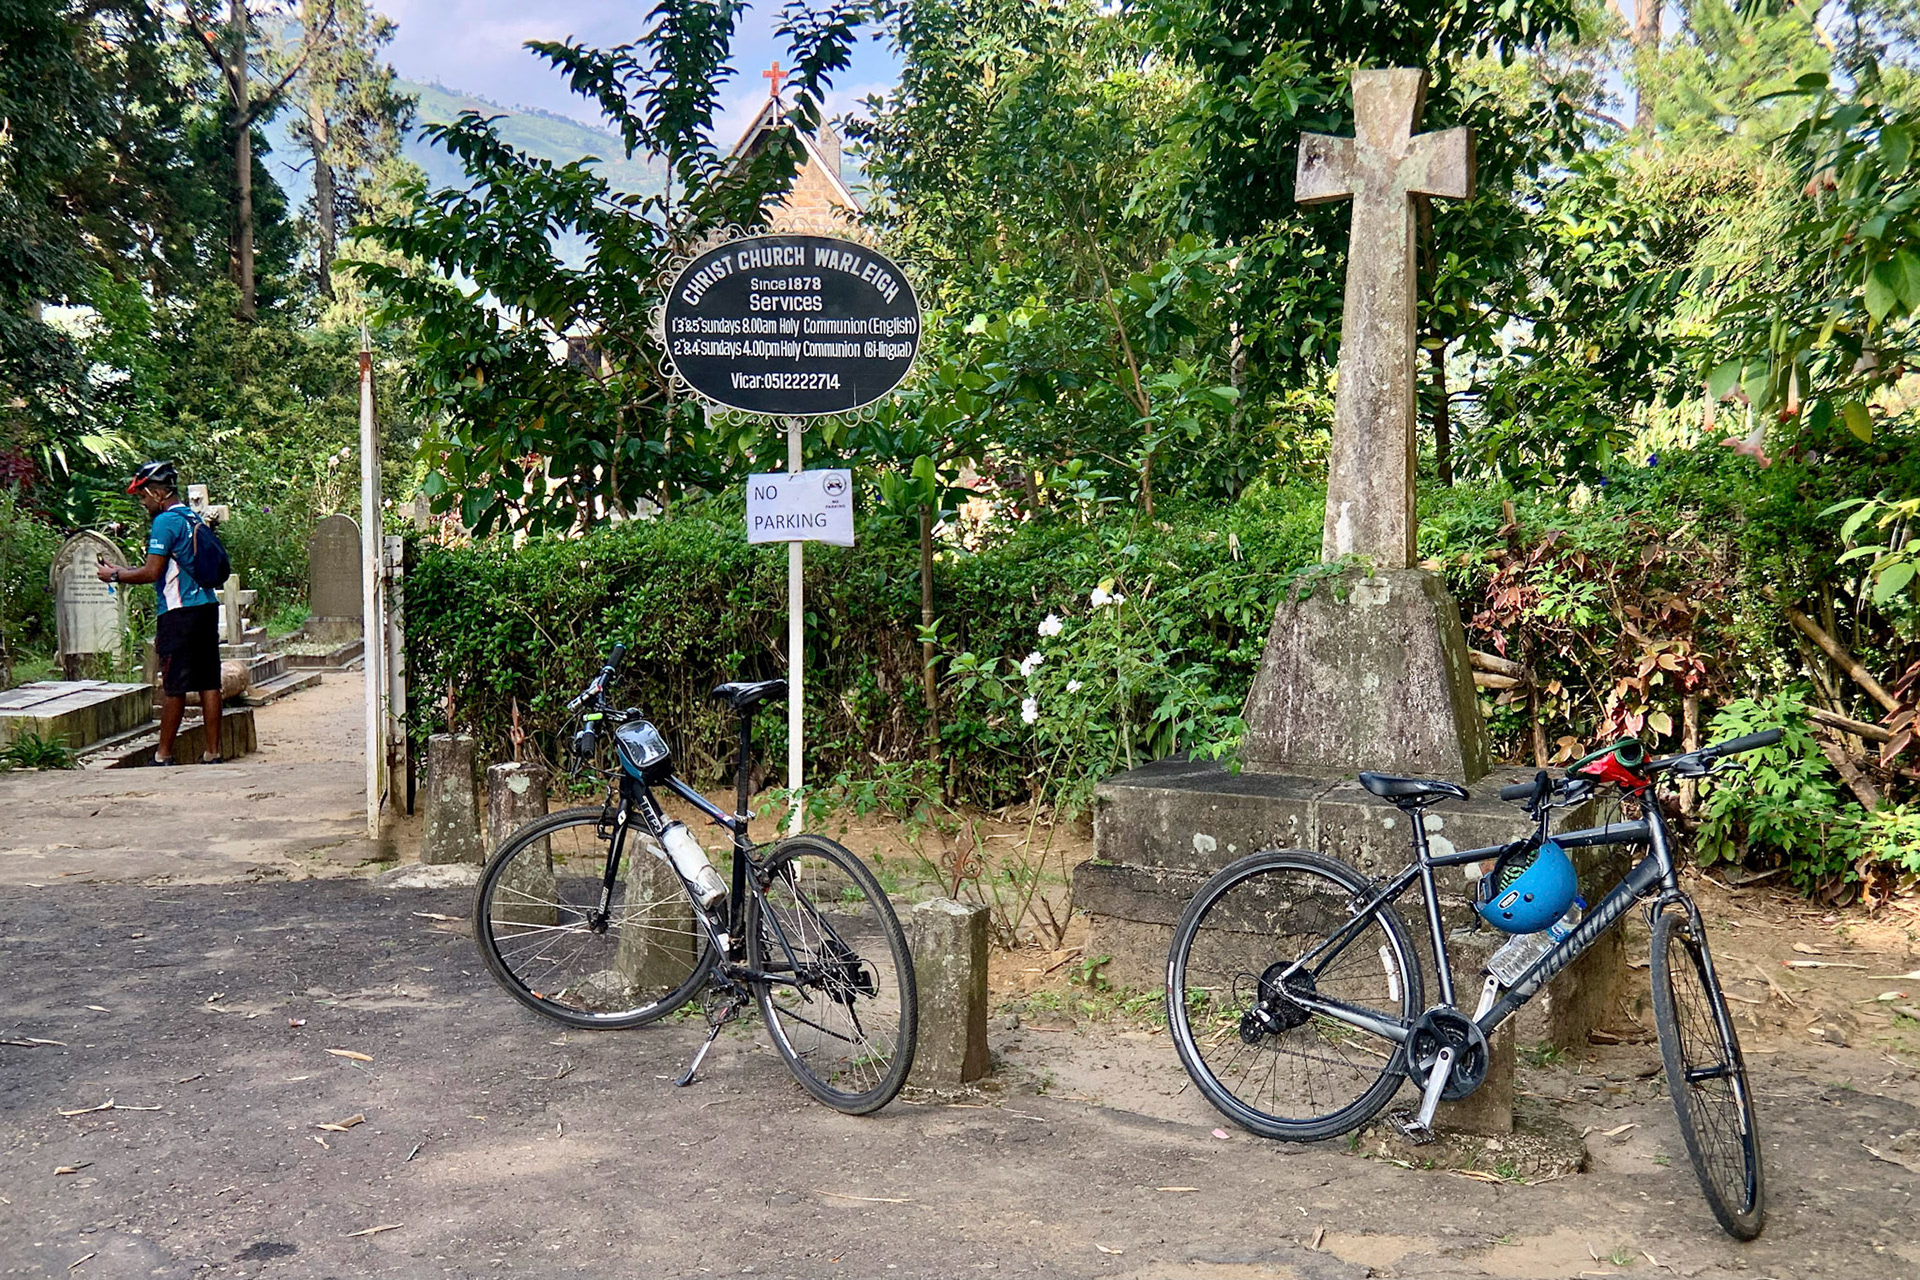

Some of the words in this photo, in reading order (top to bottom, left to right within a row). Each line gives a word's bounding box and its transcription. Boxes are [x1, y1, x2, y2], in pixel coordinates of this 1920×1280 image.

[681, 255, 734, 307] CHRIST
[737, 246, 805, 271] CHURCH
[814, 247, 900, 305] WARLEIGH
[750, 277, 787, 291] Since
[787, 277, 822, 291] 1878
[749, 293, 823, 312] Services
[741, 317, 777, 334] 8.00am
[779, 317, 800, 338] Holy
[803, 316, 868, 335] Communion
[868, 316, 917, 338] (English)
[742, 339, 780, 360] 4.00pm
[780, 340, 801, 362] Holy
[802, 340, 861, 358] Communion
[863, 340, 913, 361] (Bi-lingual)
[754, 485, 778, 501] NO
[754, 512, 827, 531] PARKING
